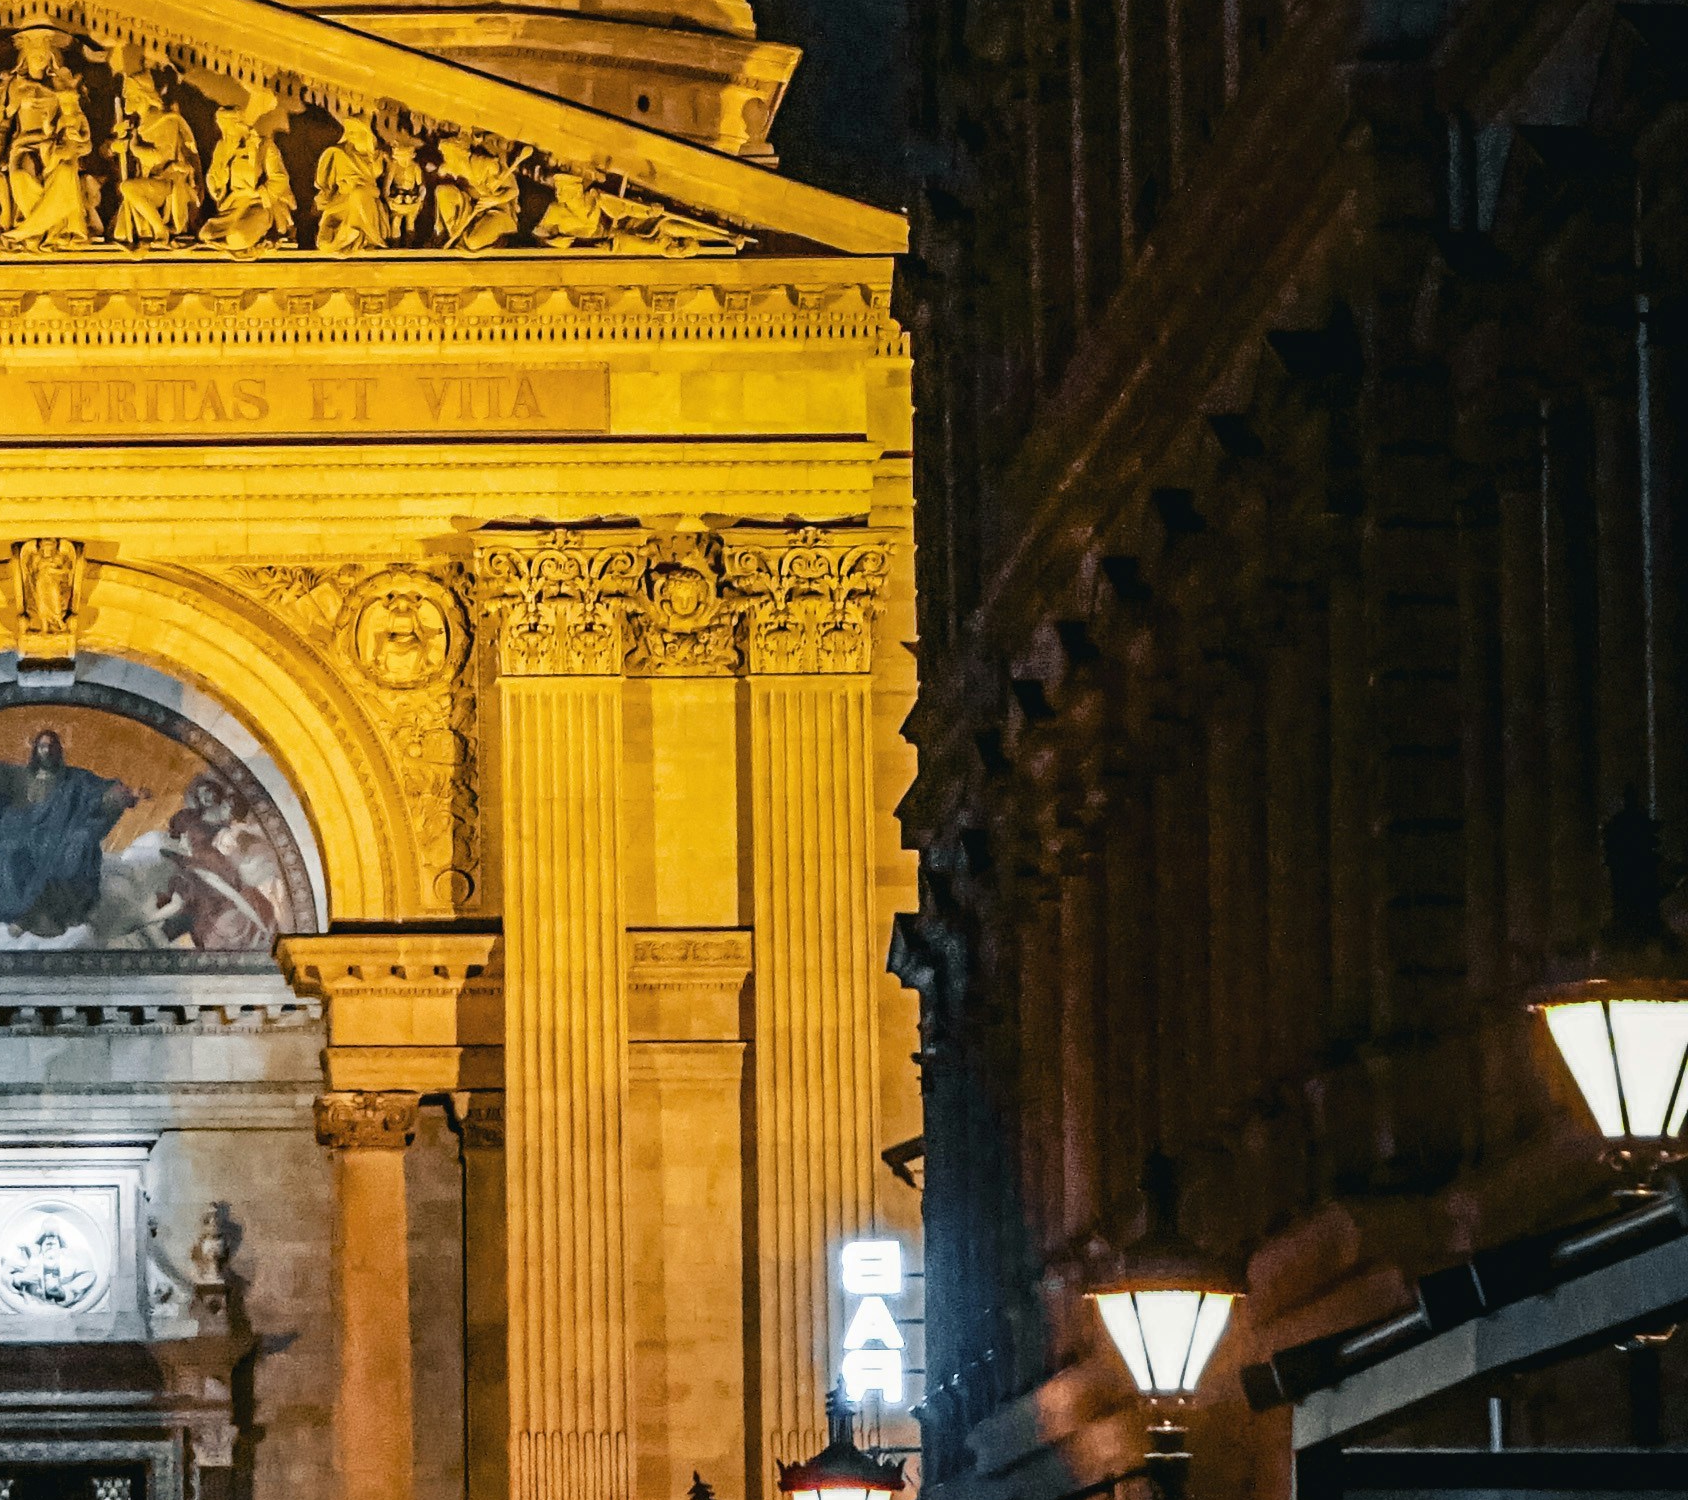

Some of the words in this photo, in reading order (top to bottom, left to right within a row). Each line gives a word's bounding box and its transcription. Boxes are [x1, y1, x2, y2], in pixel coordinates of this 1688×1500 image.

[27, 379, 269, 424] VERITAS
[308, 377, 378, 422] ET
[417, 376, 545, 420] VITA
